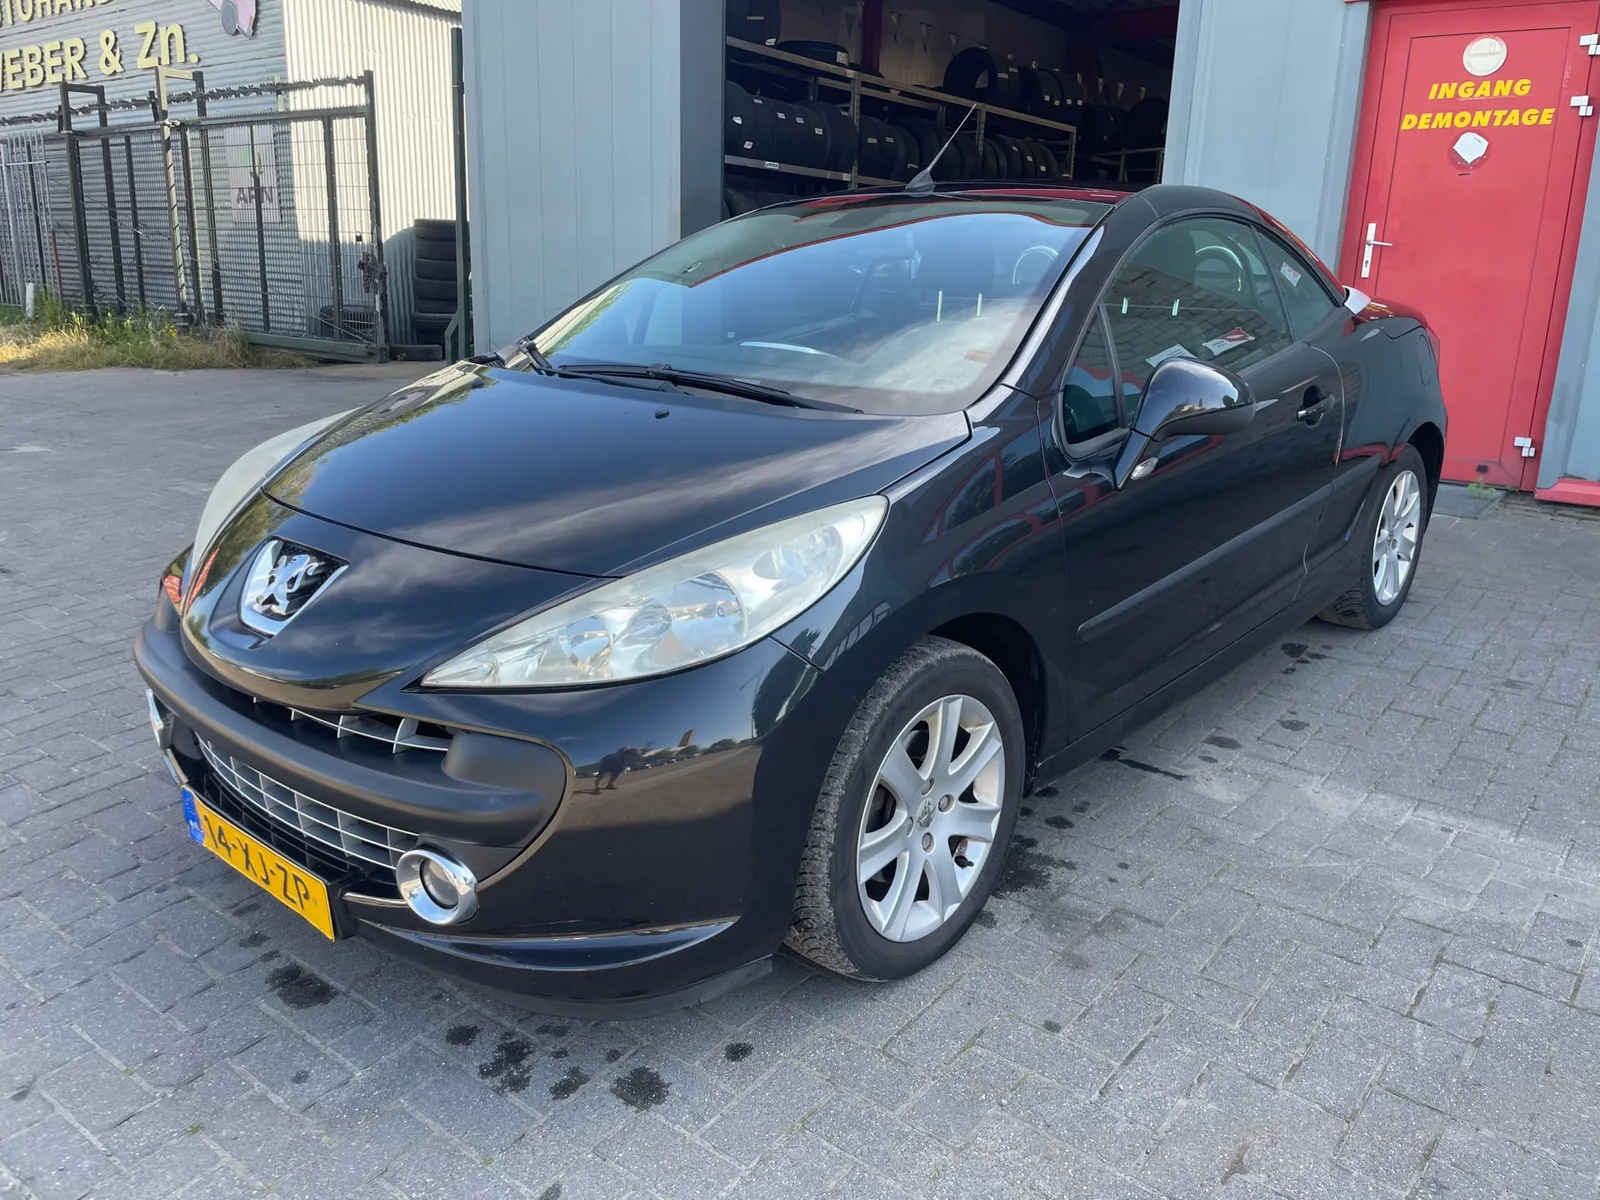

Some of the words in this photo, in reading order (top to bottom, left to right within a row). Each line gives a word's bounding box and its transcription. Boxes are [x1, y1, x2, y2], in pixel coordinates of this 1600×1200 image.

[0, 37, 88, 92] EBER
[99, 29, 124, 76] &
[134, 20, 200, 69] Zn.
[1428, 78, 1532, 100] INGANG
[1400, 108, 1556, 130] DEMONTAGE
[204, 814, 310, 911] 14-XJ-ZP
